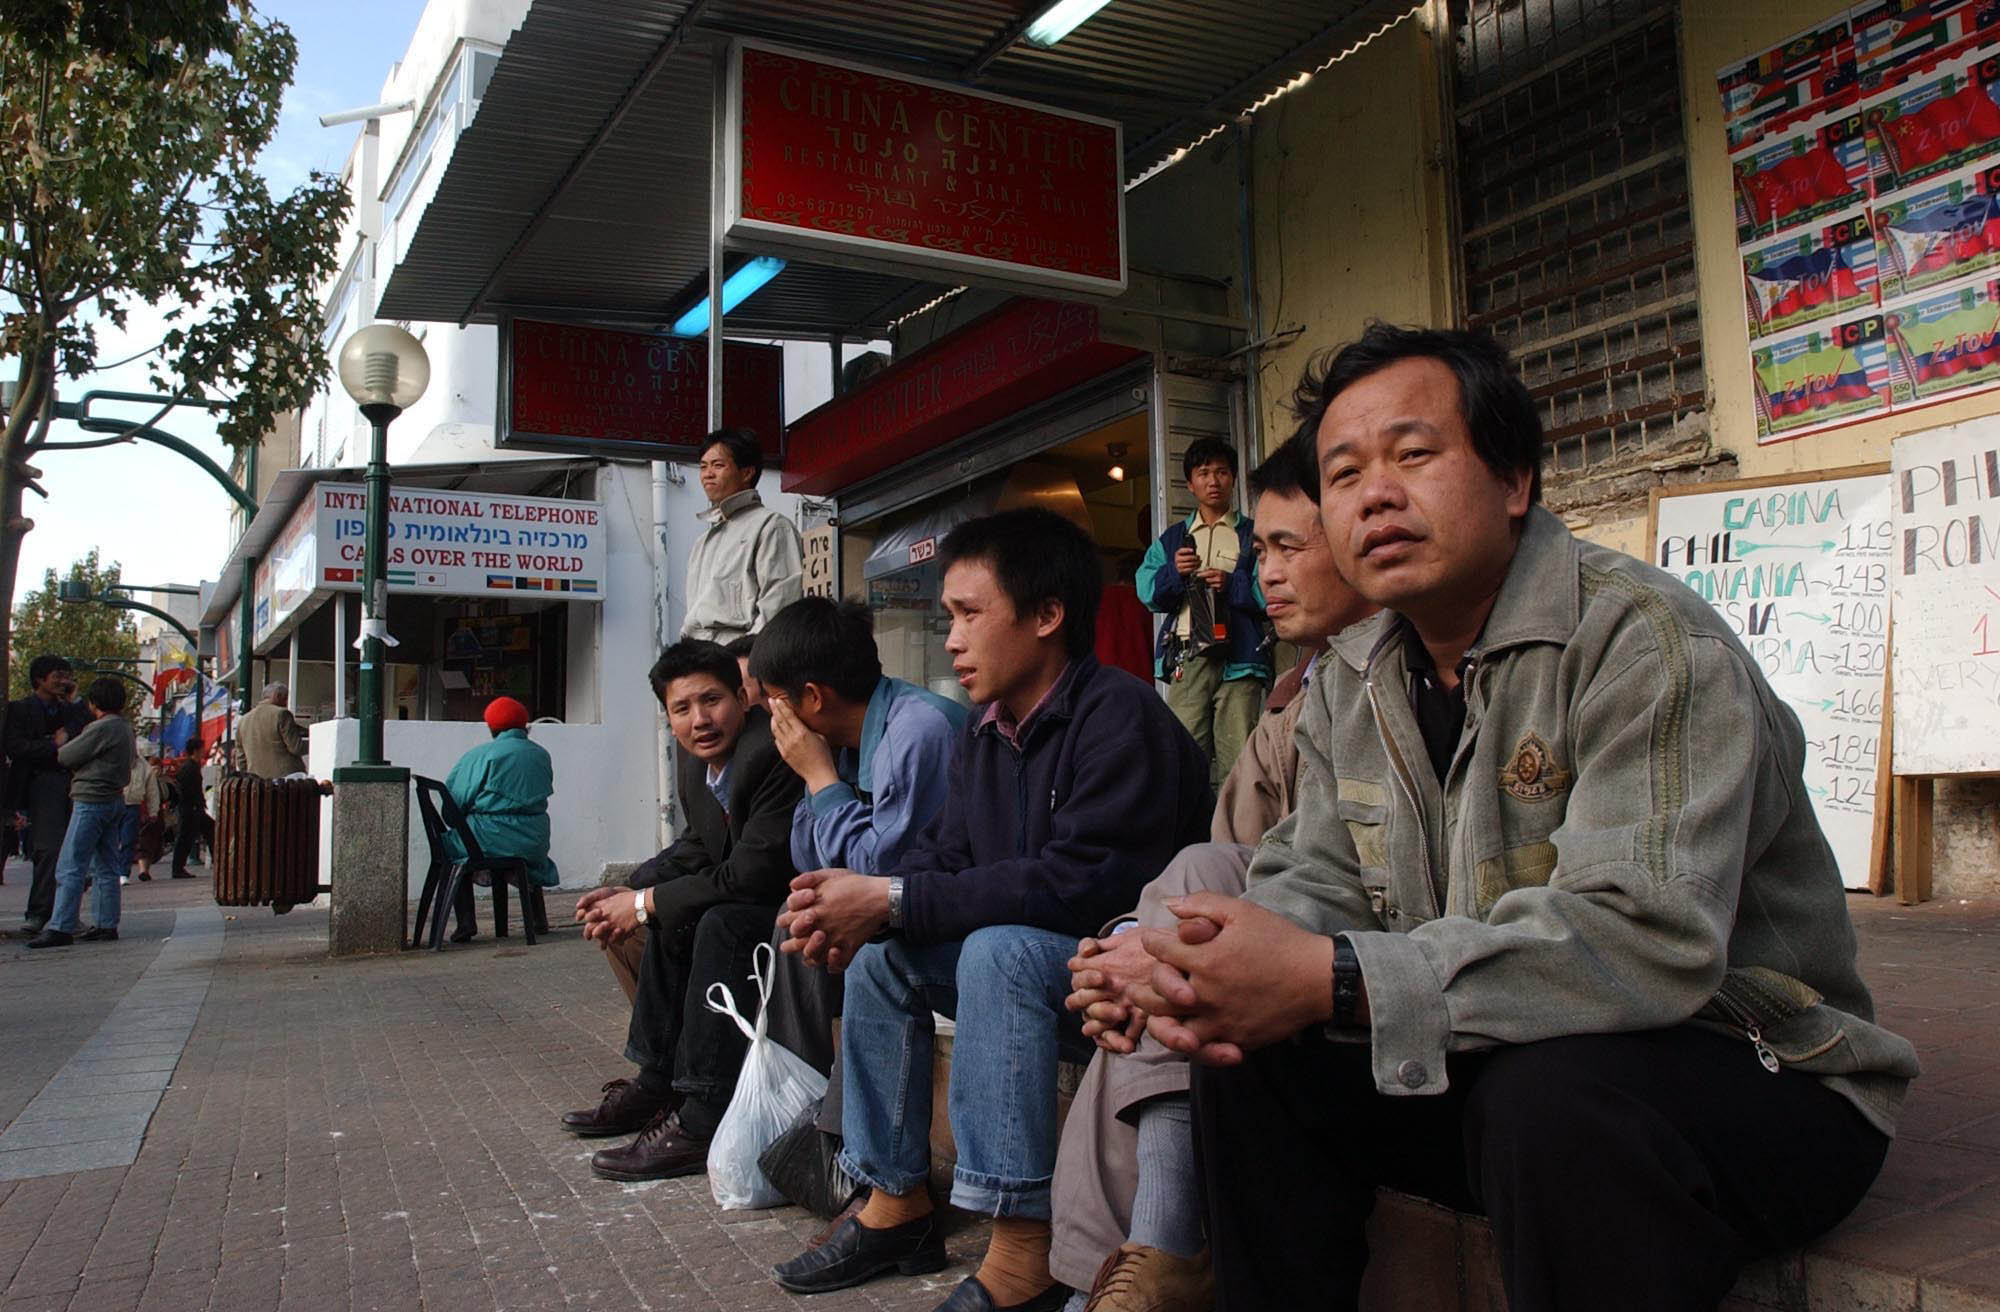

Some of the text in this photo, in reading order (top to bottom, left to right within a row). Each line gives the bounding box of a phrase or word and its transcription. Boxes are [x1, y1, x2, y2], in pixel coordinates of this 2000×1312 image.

[778, 75, 1088, 172] CHINA CENTER
[824, 125, 919, 163] סנטר
[783, 143, 929, 188] RESTAURANT
[945, 174, 959, 193] &
[1836, 218, 1867, 241] CP
[1845, 319, 1878, 342] CP
[538, 336, 630, 369] CHINA
[1894, 382, 1911, 394] 550
[324, 492, 599, 526] INTNATIONAL TELEPHONE
[1723, 488, 1845, 536] CABINA
[404, 522, 512, 546] בינלאומית
[518, 529, 588, 550] מרכזיה
[1661, 531, 1742, 568] PHIL
[341, 544, 583, 572] CAS OVER THE WORLD
[911, 542, 933, 560] כשר
[1670, 561, 1808, 601] OMANIA
